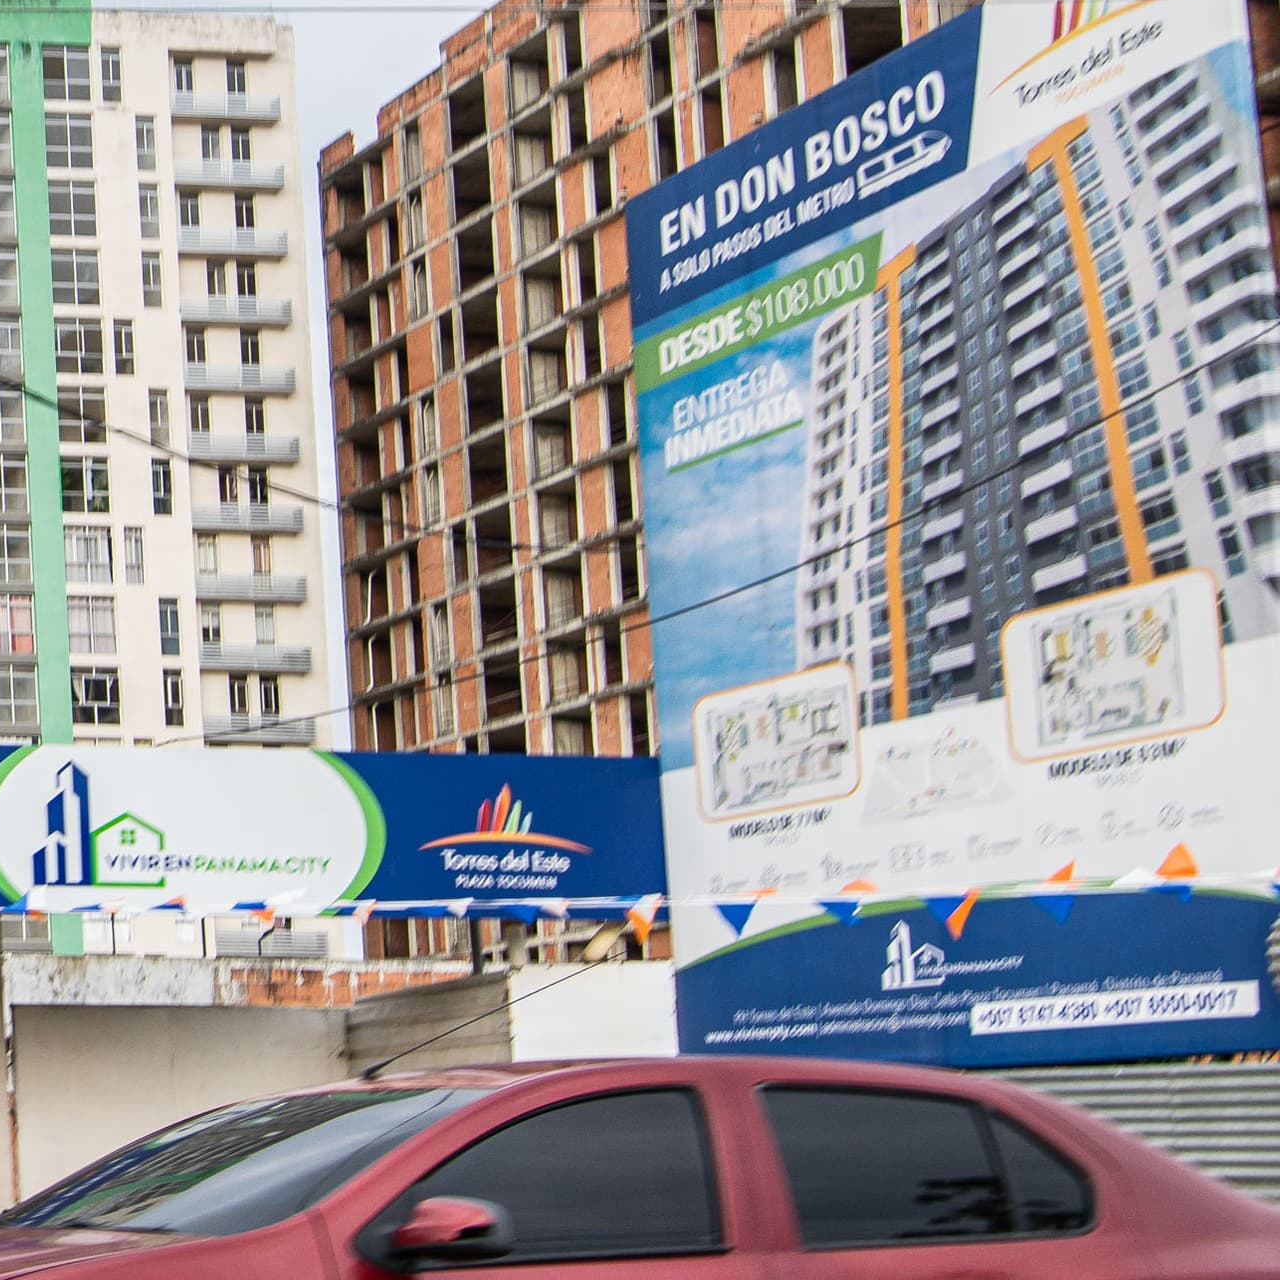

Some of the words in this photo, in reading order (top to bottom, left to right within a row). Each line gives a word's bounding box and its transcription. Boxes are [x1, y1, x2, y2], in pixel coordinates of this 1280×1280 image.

[1013, 65, 1076, 108] Torres
[1080, 37, 1114, 73] del
[1118, 20, 1163, 57] Este
[659, 194, 707, 257] EN
[715, 147, 797, 229] DON
[803, 70, 946, 183] BOSCO
[659, 267, 671, 295] A
[672, 248, 711, 287] SOLO
[711, 223, 762, 270] PASOS
[762, 207, 796, 243] DEL
[796, 176, 856, 227] METRO
[658, 306, 745, 376] DESDE
[664, 388, 805, 468] INMEDIATA
[672, 360, 790, 433] ENTREGA
[441, 849, 499, 872] Torres
[500, 849, 530, 872] del
[531, 850, 571, 873] Este
[455, 873, 496, 889] PLAZA
[496, 874, 558, 890] TOCUMEN
